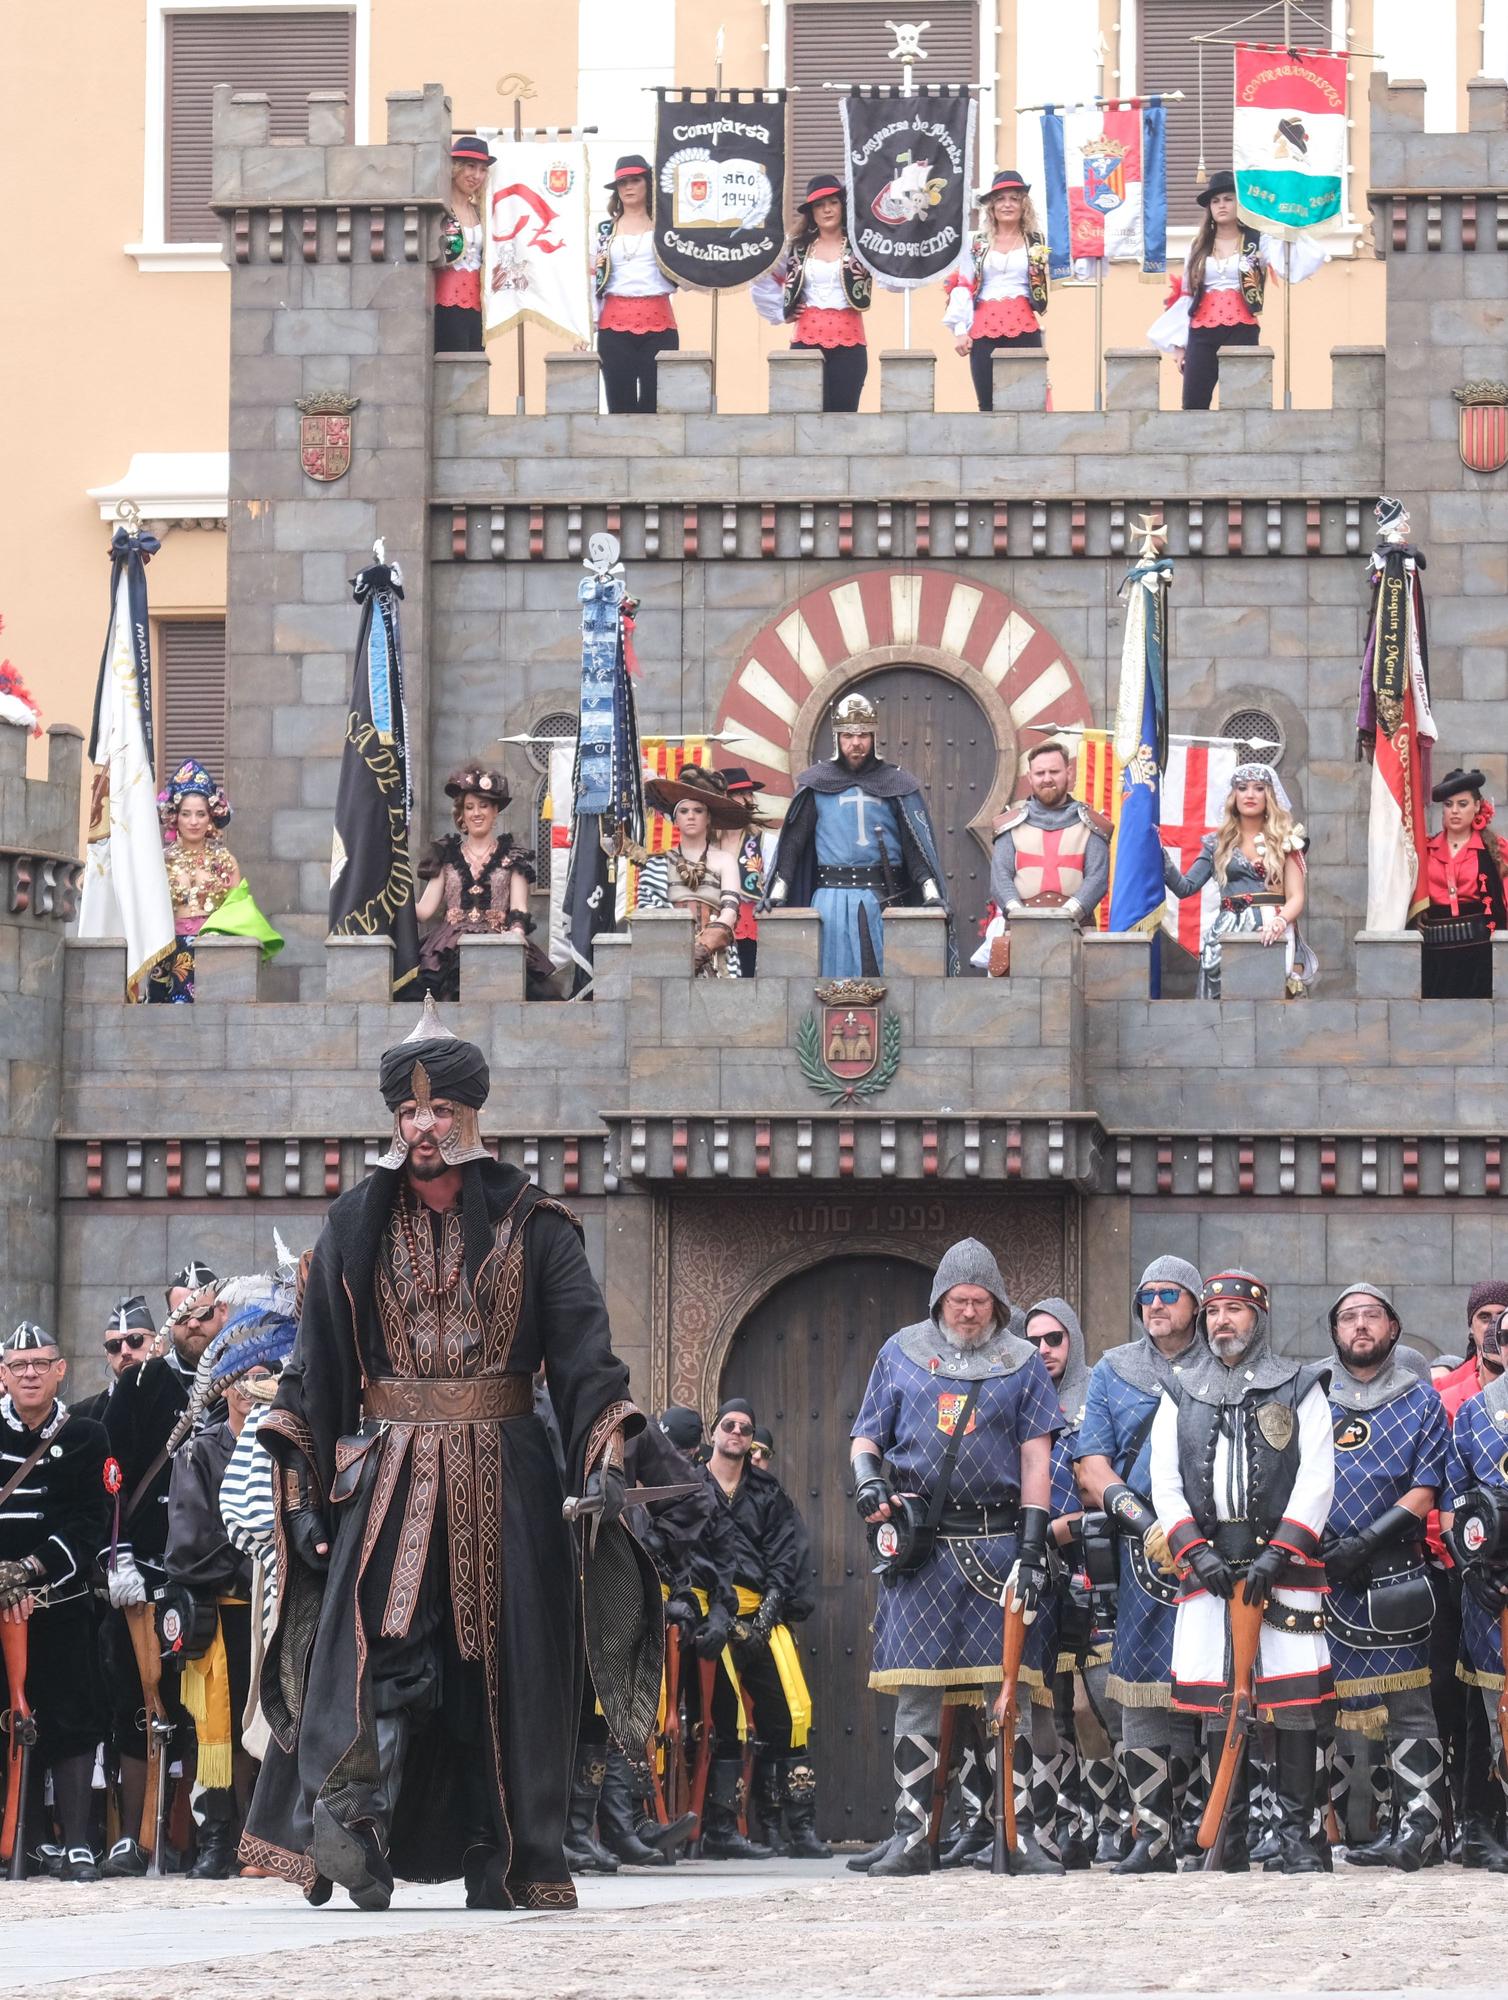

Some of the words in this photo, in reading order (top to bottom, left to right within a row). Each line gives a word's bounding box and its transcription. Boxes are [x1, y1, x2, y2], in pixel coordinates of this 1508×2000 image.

[1242, 65, 1342, 107] CONTRABANDISTAS
[673, 117, 769, 146] Comparsa
[912, 114, 929, 131] de
[722, 193, 757, 207] 1944
[858, 229, 893, 256] AÑO
[1078, 220, 1136, 240] Crisanos
[664, 231, 773, 261] Estudiantes
